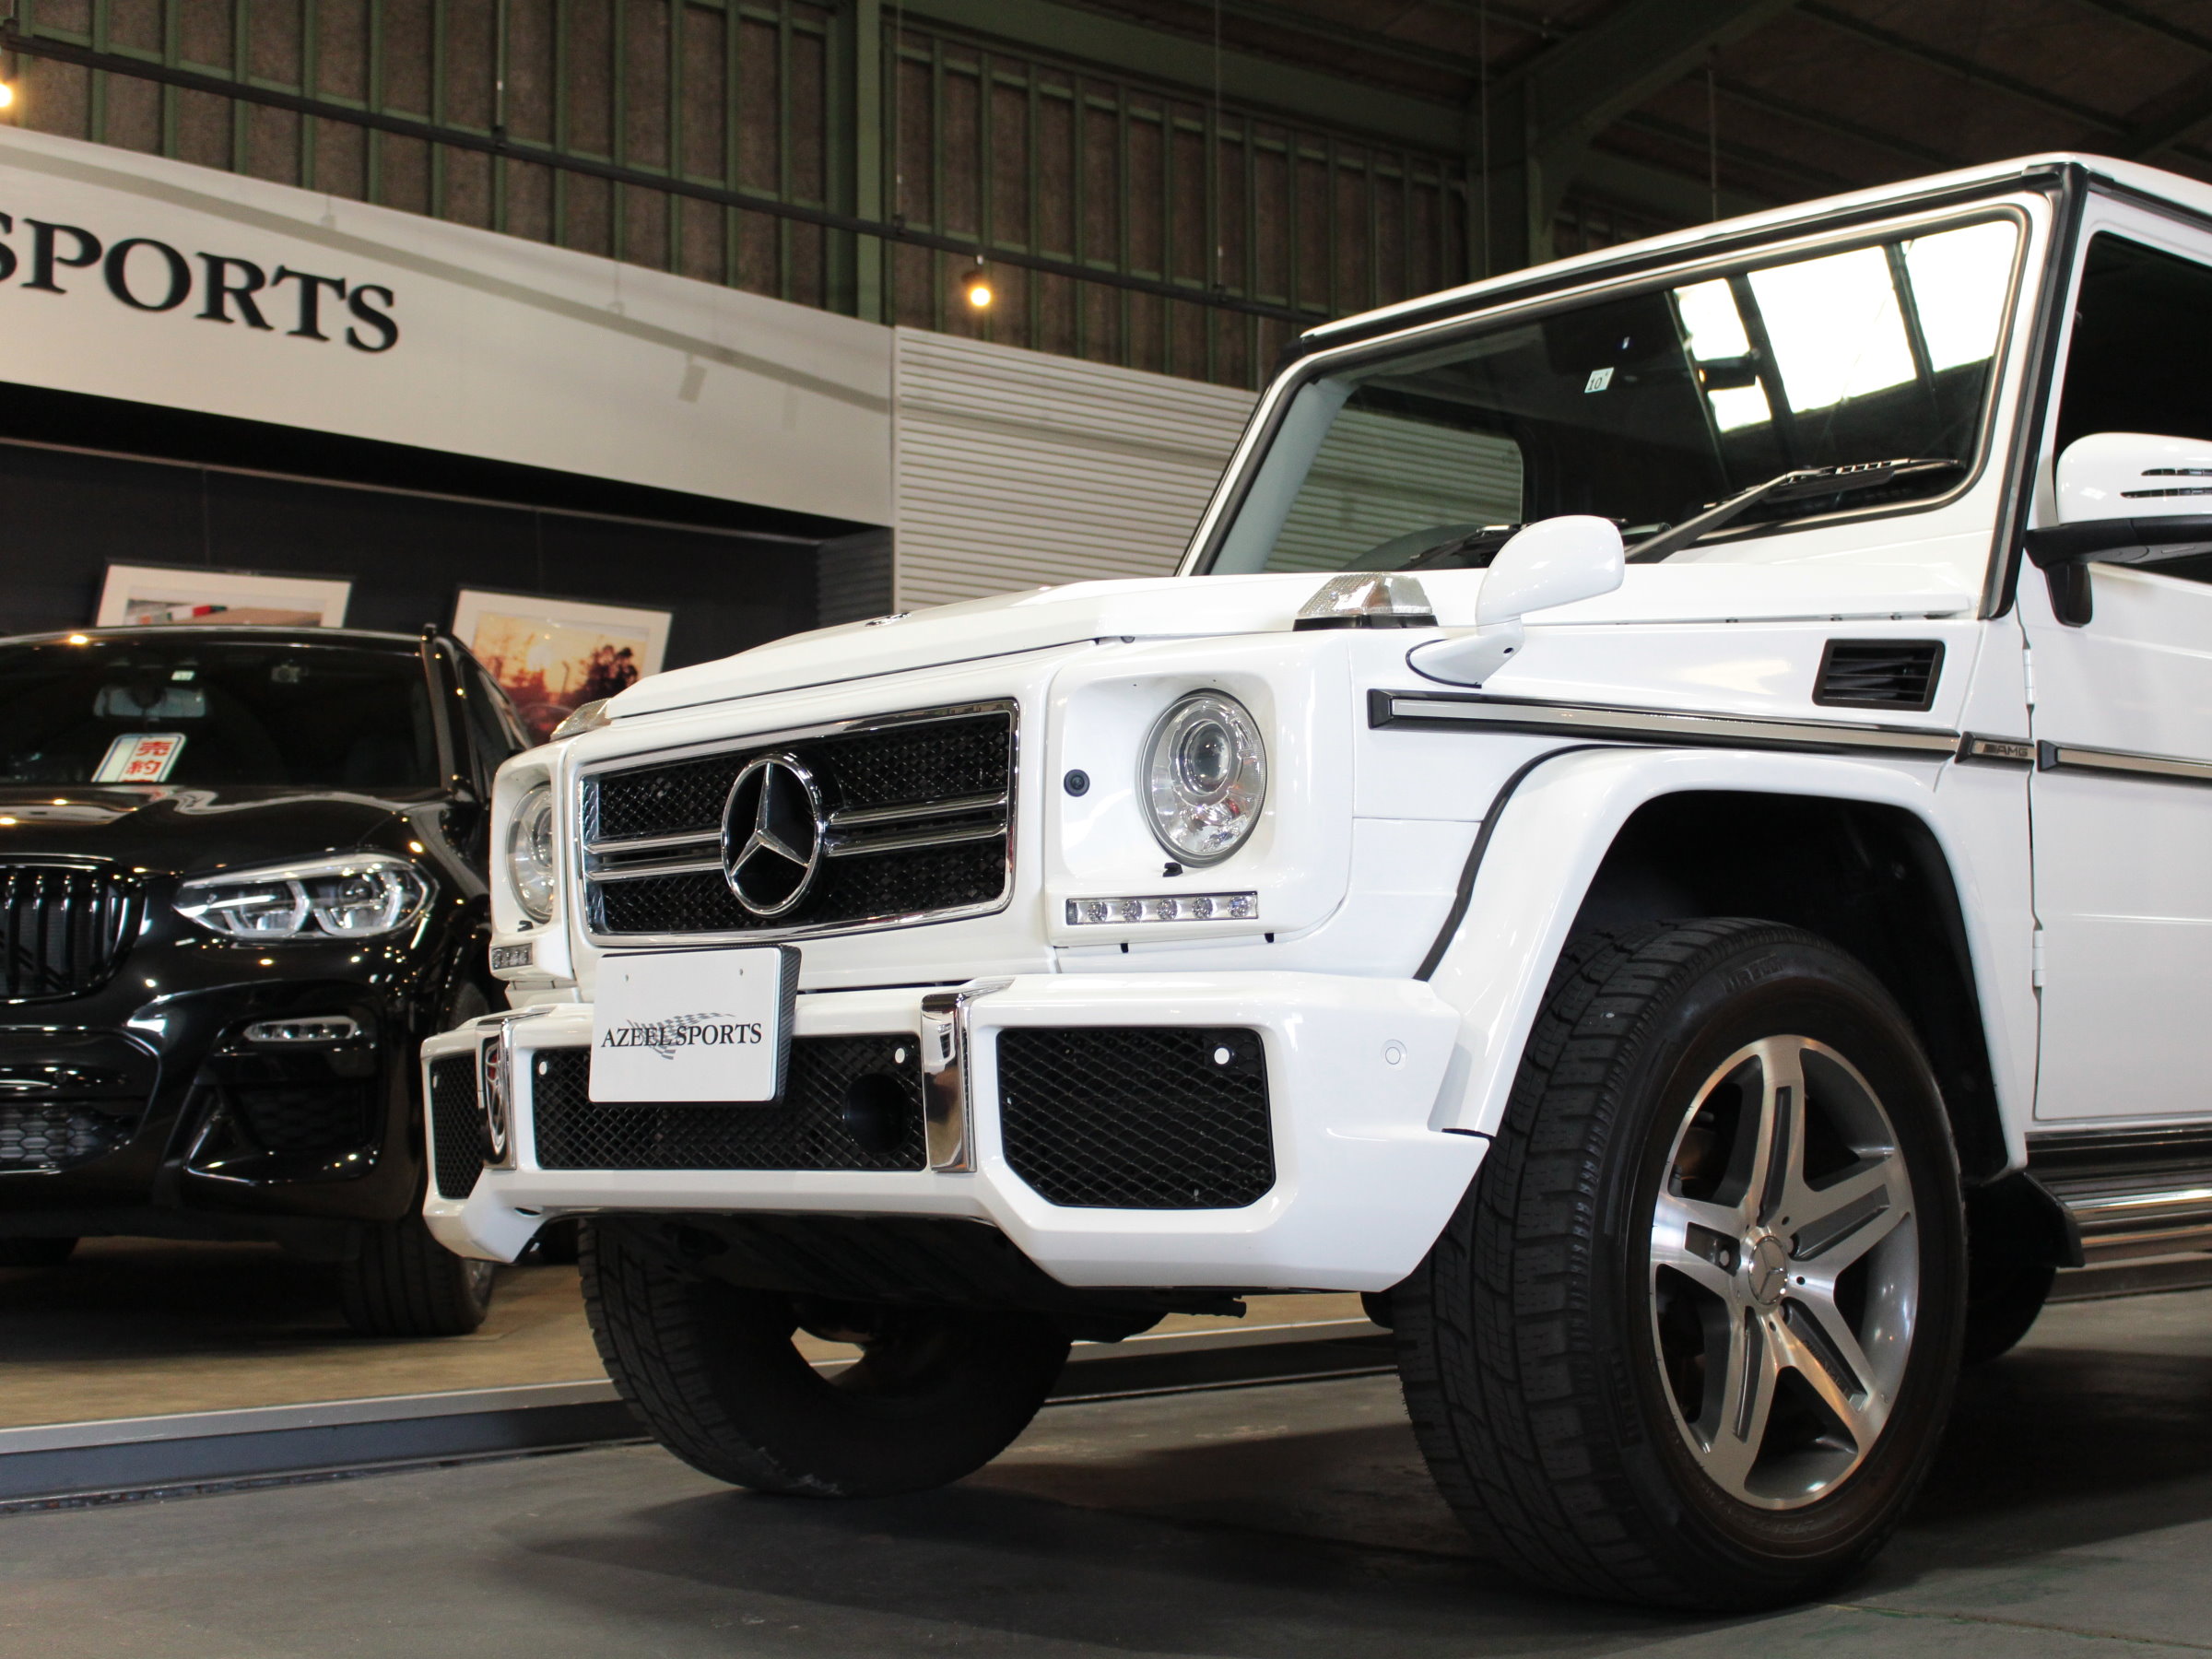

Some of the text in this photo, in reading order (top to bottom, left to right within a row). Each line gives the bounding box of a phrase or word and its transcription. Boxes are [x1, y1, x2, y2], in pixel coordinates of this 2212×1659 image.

[123, 741, 173, 782] 売約
[1996, 745, 2029, 757] AMG
[601, 1023, 762, 1048] AZEEL SPORTS
